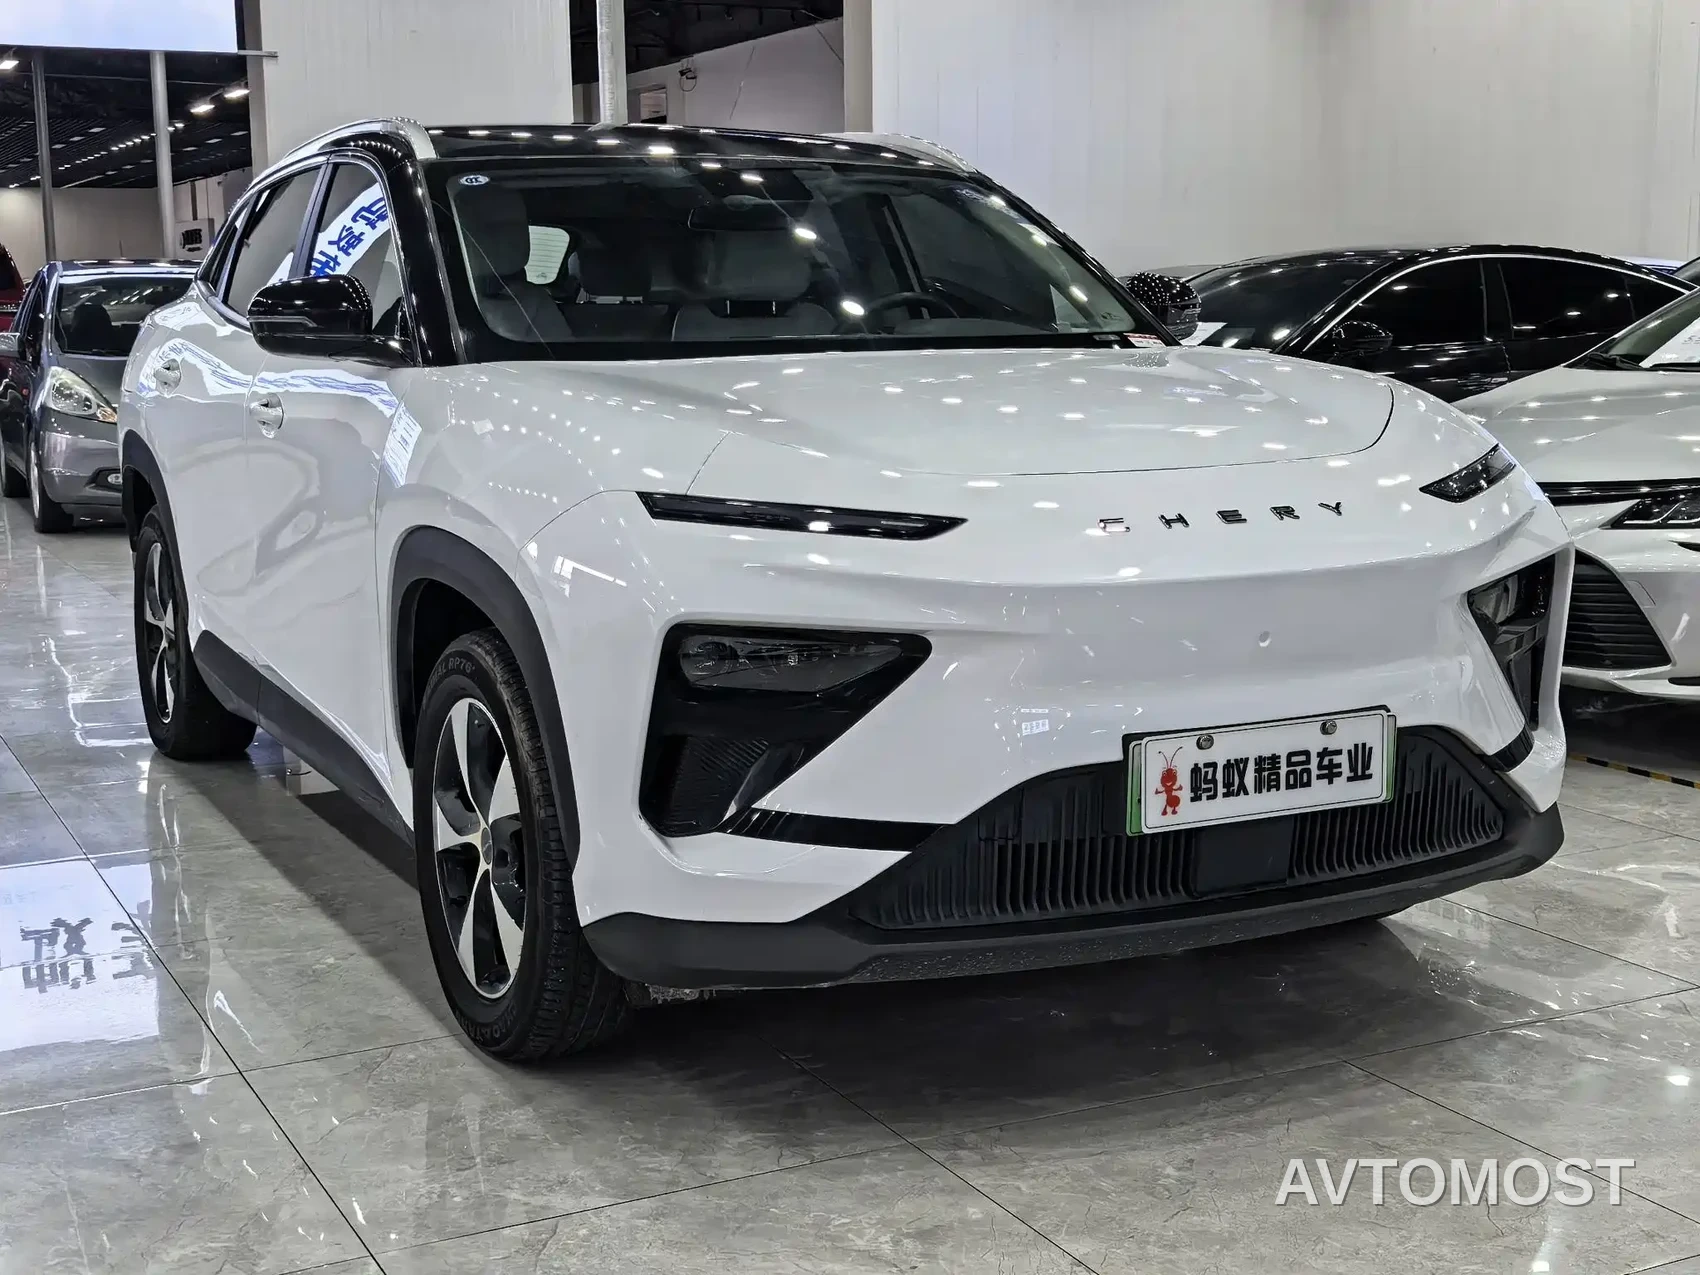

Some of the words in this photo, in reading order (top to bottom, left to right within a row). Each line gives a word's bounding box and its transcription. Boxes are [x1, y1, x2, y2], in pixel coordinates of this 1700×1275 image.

[1098, 501, 1342, 532] CHERY
[1190, 742, 1373, 803] 蚂蚁精品车业
